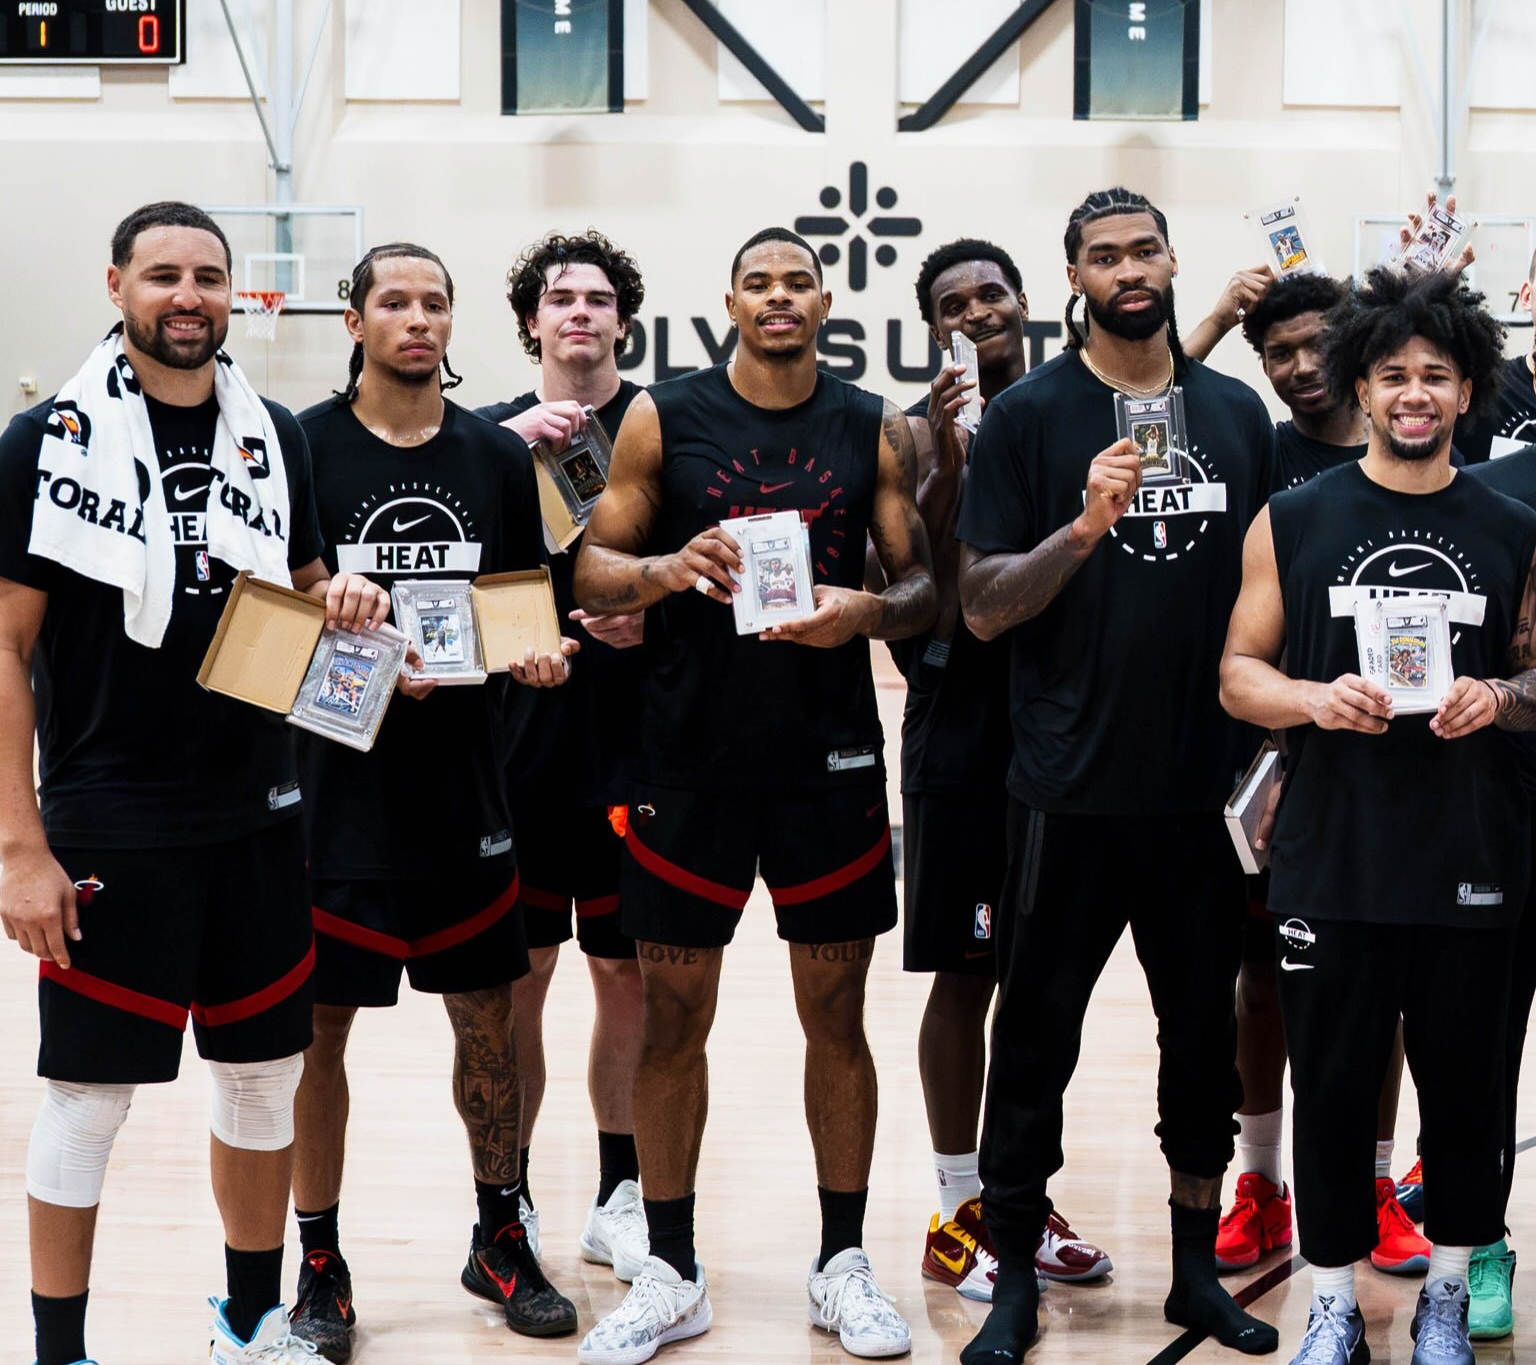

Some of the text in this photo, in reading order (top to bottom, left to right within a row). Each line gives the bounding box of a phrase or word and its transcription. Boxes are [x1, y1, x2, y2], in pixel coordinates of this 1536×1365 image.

[18, 2, 58, 17] PERIOD
[40, 20, 47, 47] 1
[138, 14, 160, 54] 0
[337, 279, 350, 300] 8
[1508, 291, 1520, 313] 7
[617, 316, 867, 386] LYS
[170, 515, 207, 542] HE
[376, 544, 450, 571] HEAT
